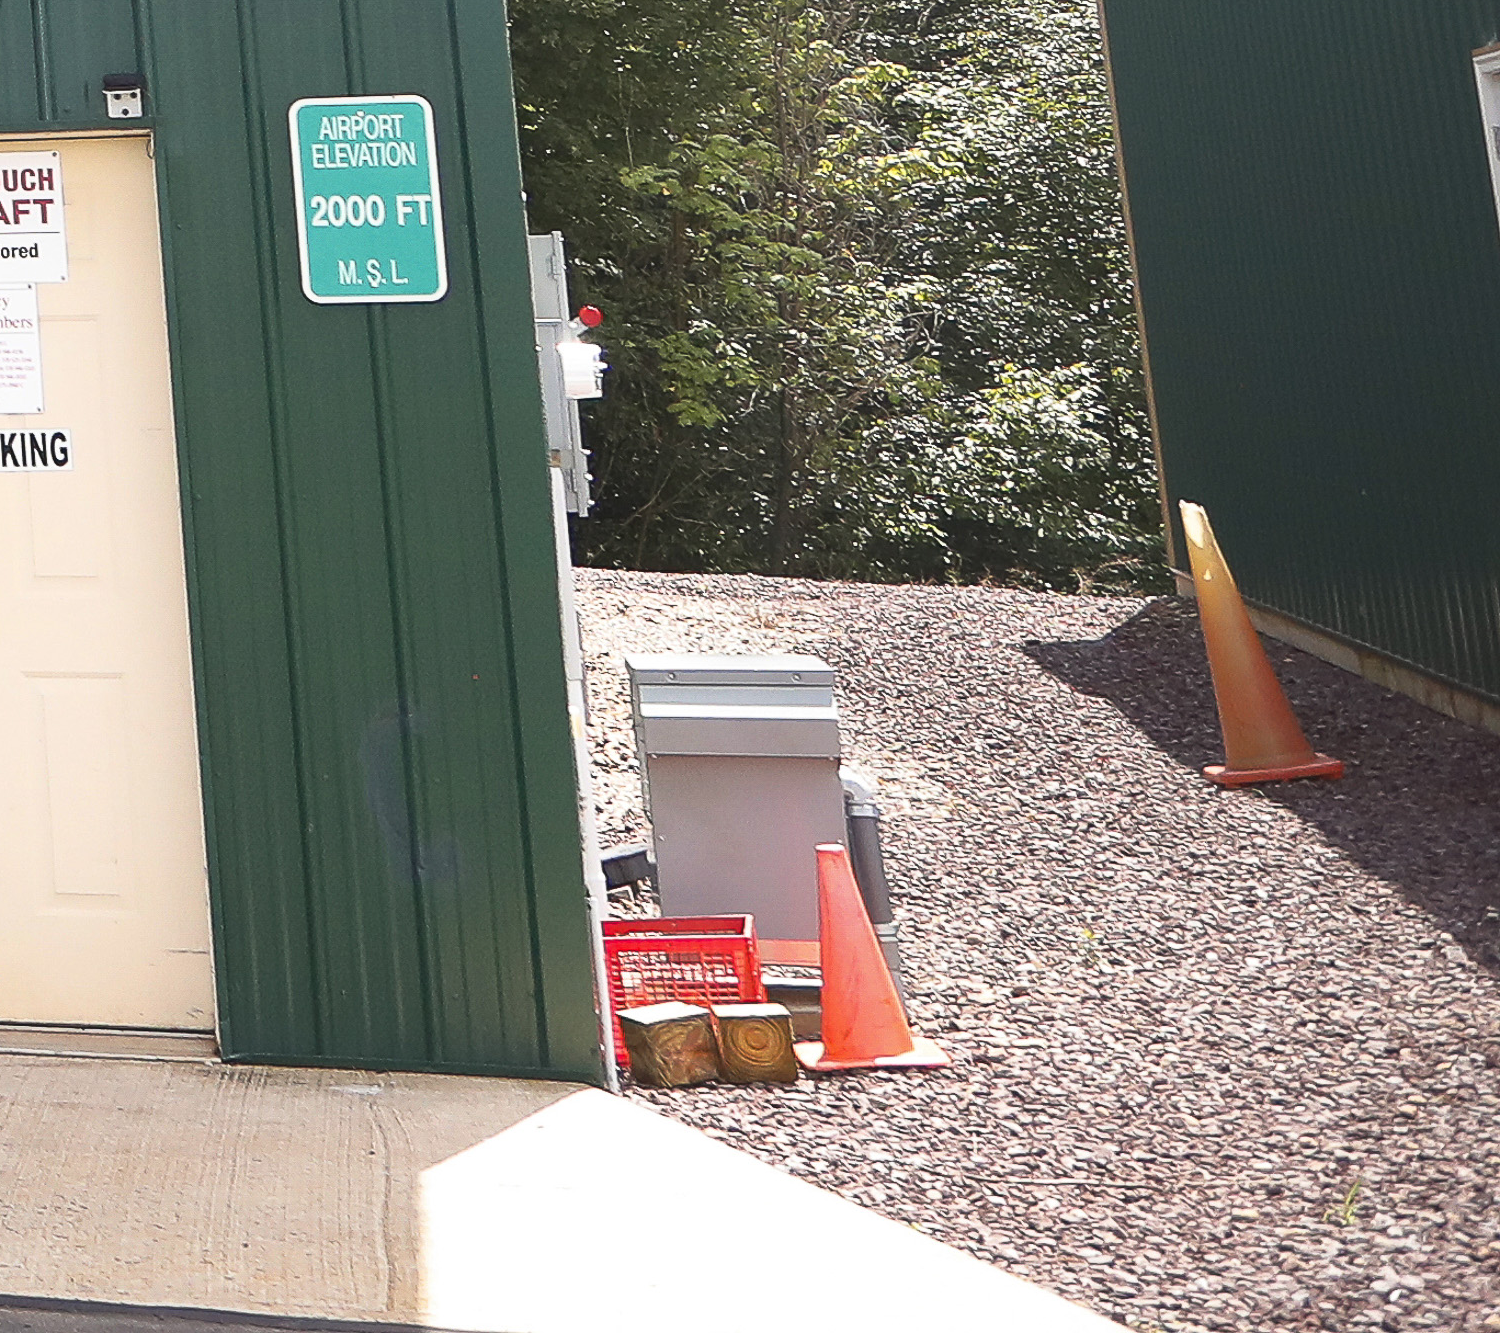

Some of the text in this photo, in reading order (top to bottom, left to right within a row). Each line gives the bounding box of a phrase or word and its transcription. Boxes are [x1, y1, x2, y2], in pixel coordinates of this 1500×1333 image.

[319, 113, 404, 141] AIRPORT
[311, 141, 417, 169] ELEVATION
[309, 193, 432, 227] 2000 FT
